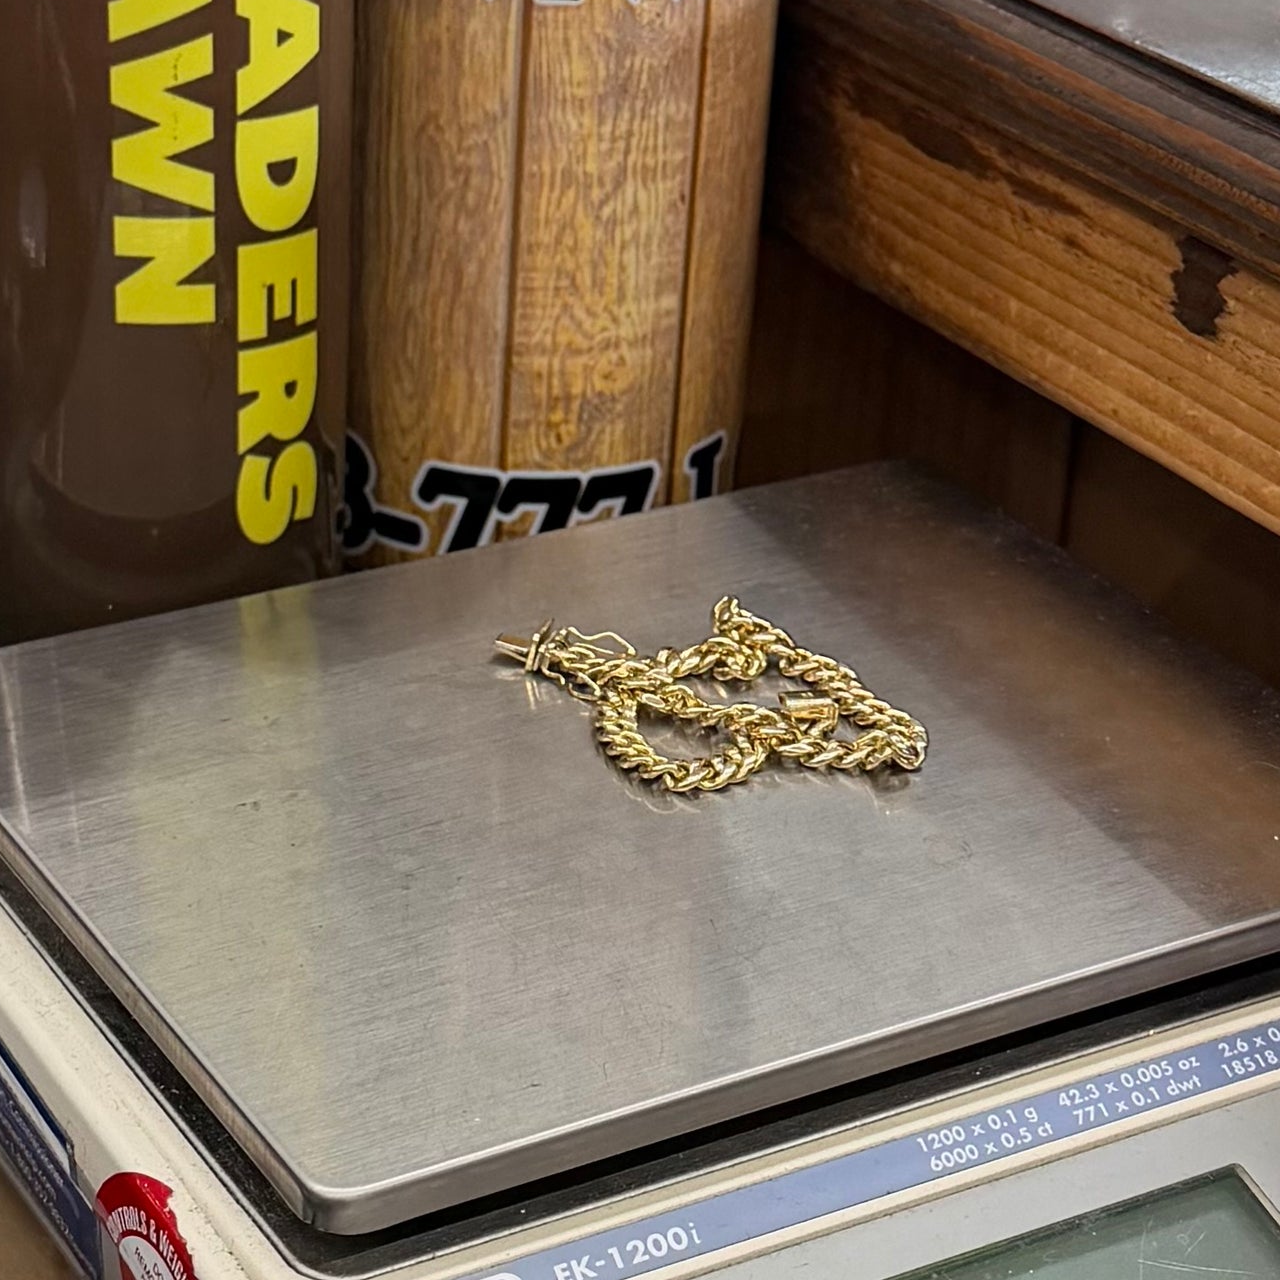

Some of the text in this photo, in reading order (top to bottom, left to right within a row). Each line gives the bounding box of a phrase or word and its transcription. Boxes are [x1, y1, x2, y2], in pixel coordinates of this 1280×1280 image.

[917, 1125, 966, 1153] 1200
[972, 1123, 985, 1136] x
[987, 1108, 1018, 1131] 0.1
[1024, 1106, 1038, 1123] g
[1058, 1084, 1100, 1108] 42.3
[1105, 1081, 1118, 1094] x
[1120, 1062, 1173, 1089] 0.005
[1178, 1056, 1200, 1071] oz
[1218, 1037, 1249, 1058] 2.6
[1253, 1034, 1266, 1048] x
[930, 1144, 979, 1172] 6000
[984, 1141, 998, 1155] x
[1001, 1126, 1032, 1149] 0.5
[1036, 1121, 1054, 1138] ct
[1073, 1101, 1110, 1126] 771
[1115, 1099, 1129, 1114] x
[1131, 1086, 1161, 1109] 0.1
[1166, 1073, 1203, 1097] dwt
[1220, 1049, 1279, 1079] 18518
